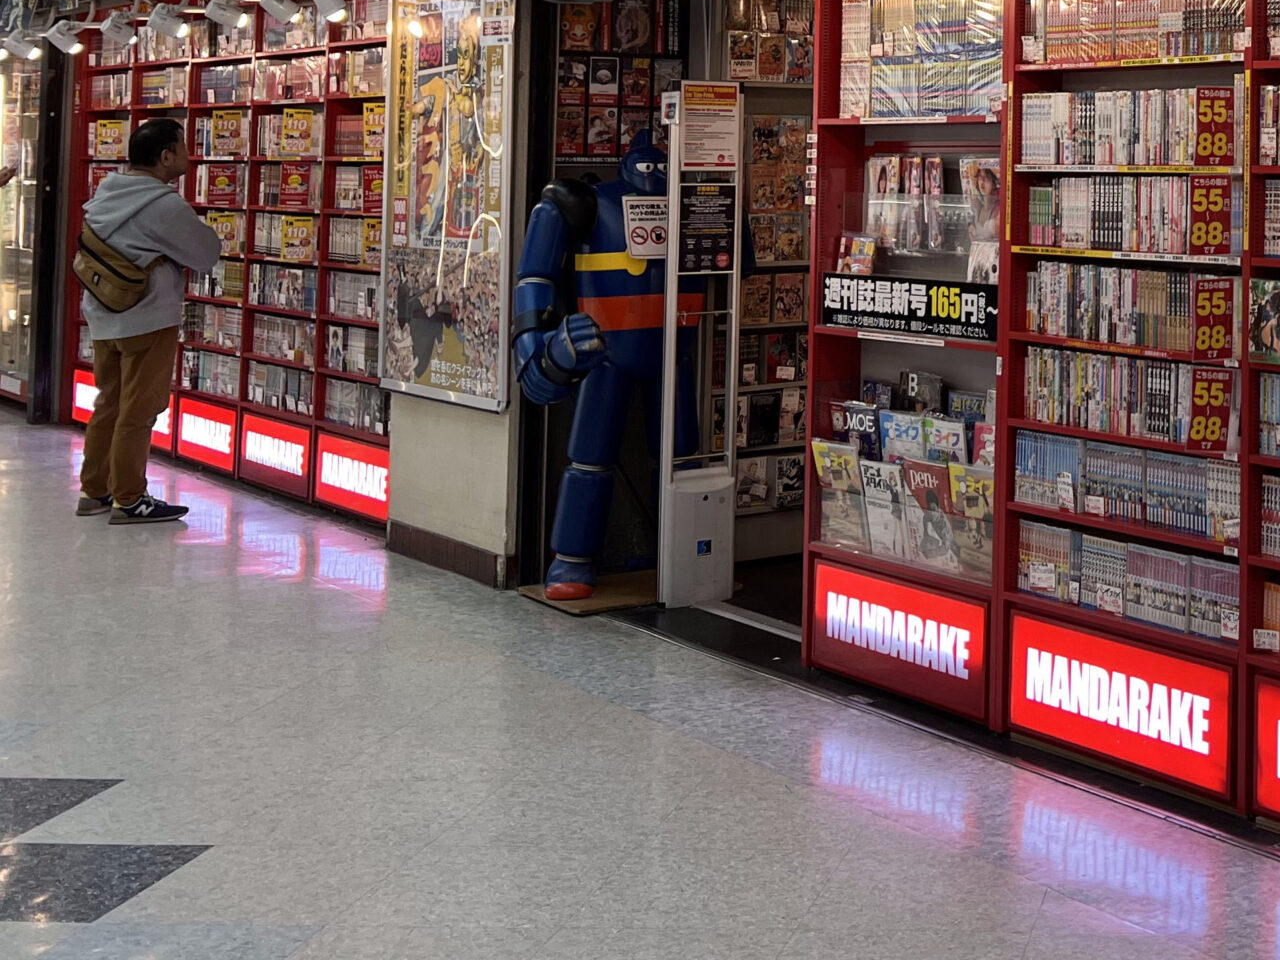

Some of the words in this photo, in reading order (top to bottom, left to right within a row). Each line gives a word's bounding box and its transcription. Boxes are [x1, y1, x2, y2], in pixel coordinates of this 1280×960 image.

[181, 412, 232, 454] MANDARAKE
[845, 412, 876, 433] MOE
[245, 430, 304, 476] MANDARAKE
[320, 451, 388, 502] MANDARAKE
[826, 591, 971, 680] MANDARAKE
[1027, 647, 1213, 755] MANDARAKE
